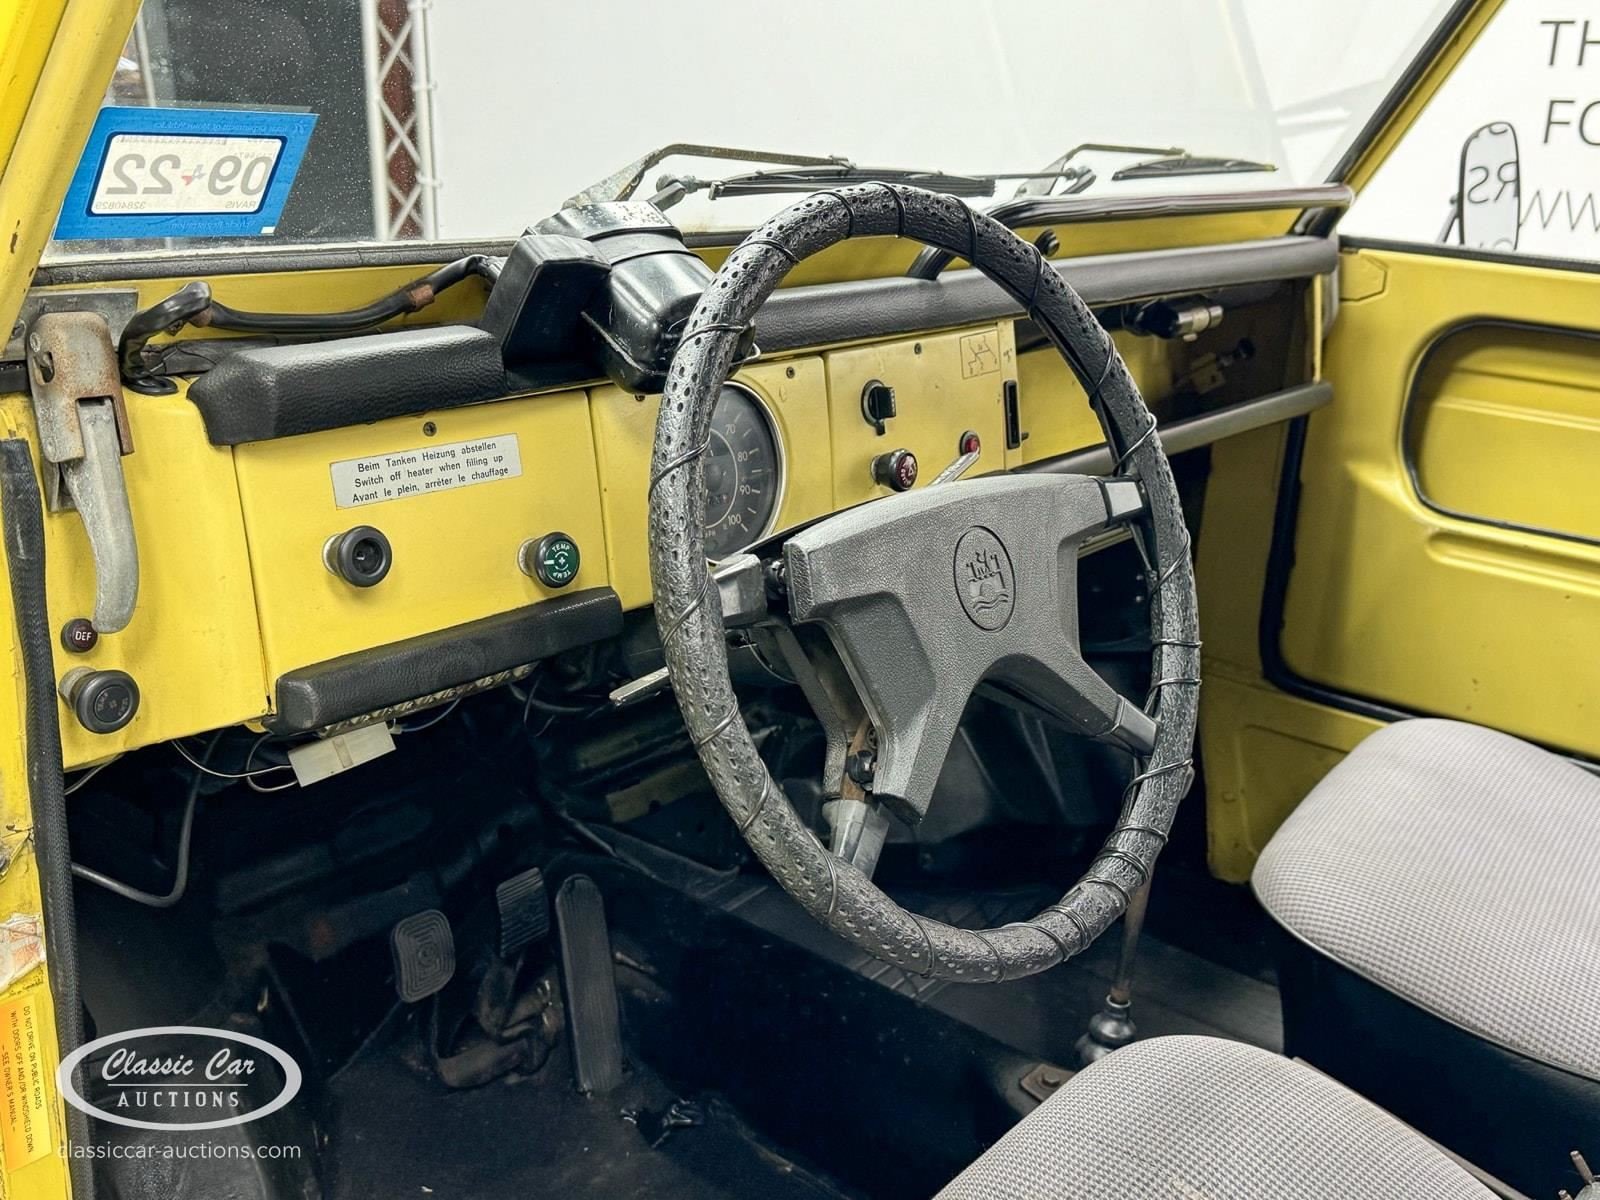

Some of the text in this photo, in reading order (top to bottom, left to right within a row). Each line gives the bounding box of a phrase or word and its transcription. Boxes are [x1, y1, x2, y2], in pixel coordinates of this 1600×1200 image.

[725, 424, 736, 436] 70
[358, 442, 496, 473] Beim Tanken Heizung abstellen
[737, 452, 748, 463] 80
[354, 455, 504, 488] Switch off heater when filling up
[352, 491, 378, 504] Avant
[384, 487, 392, 496] le
[398, 484, 420, 496] plein,
[458, 474, 466, 484] le
[472, 466, 509, 481] chauffage
[740, 485, 751, 495] 90
[728, 514, 742, 526] 100
[552, 543, 570, 552] TEMP
[552, 570, 572, 579] TEMP
[75, 630, 92, 641] DEF
[24, 1006, 31, 1016] DO
[26, 1031, 36, 1050] DRIVE
[4, 1067, 13, 1098] OWNERS
[12, 1029, 22, 1051] DOORS
[26, 1134, 34, 1152] DOWN
[34, 1086, 42, 1110] ROADS
